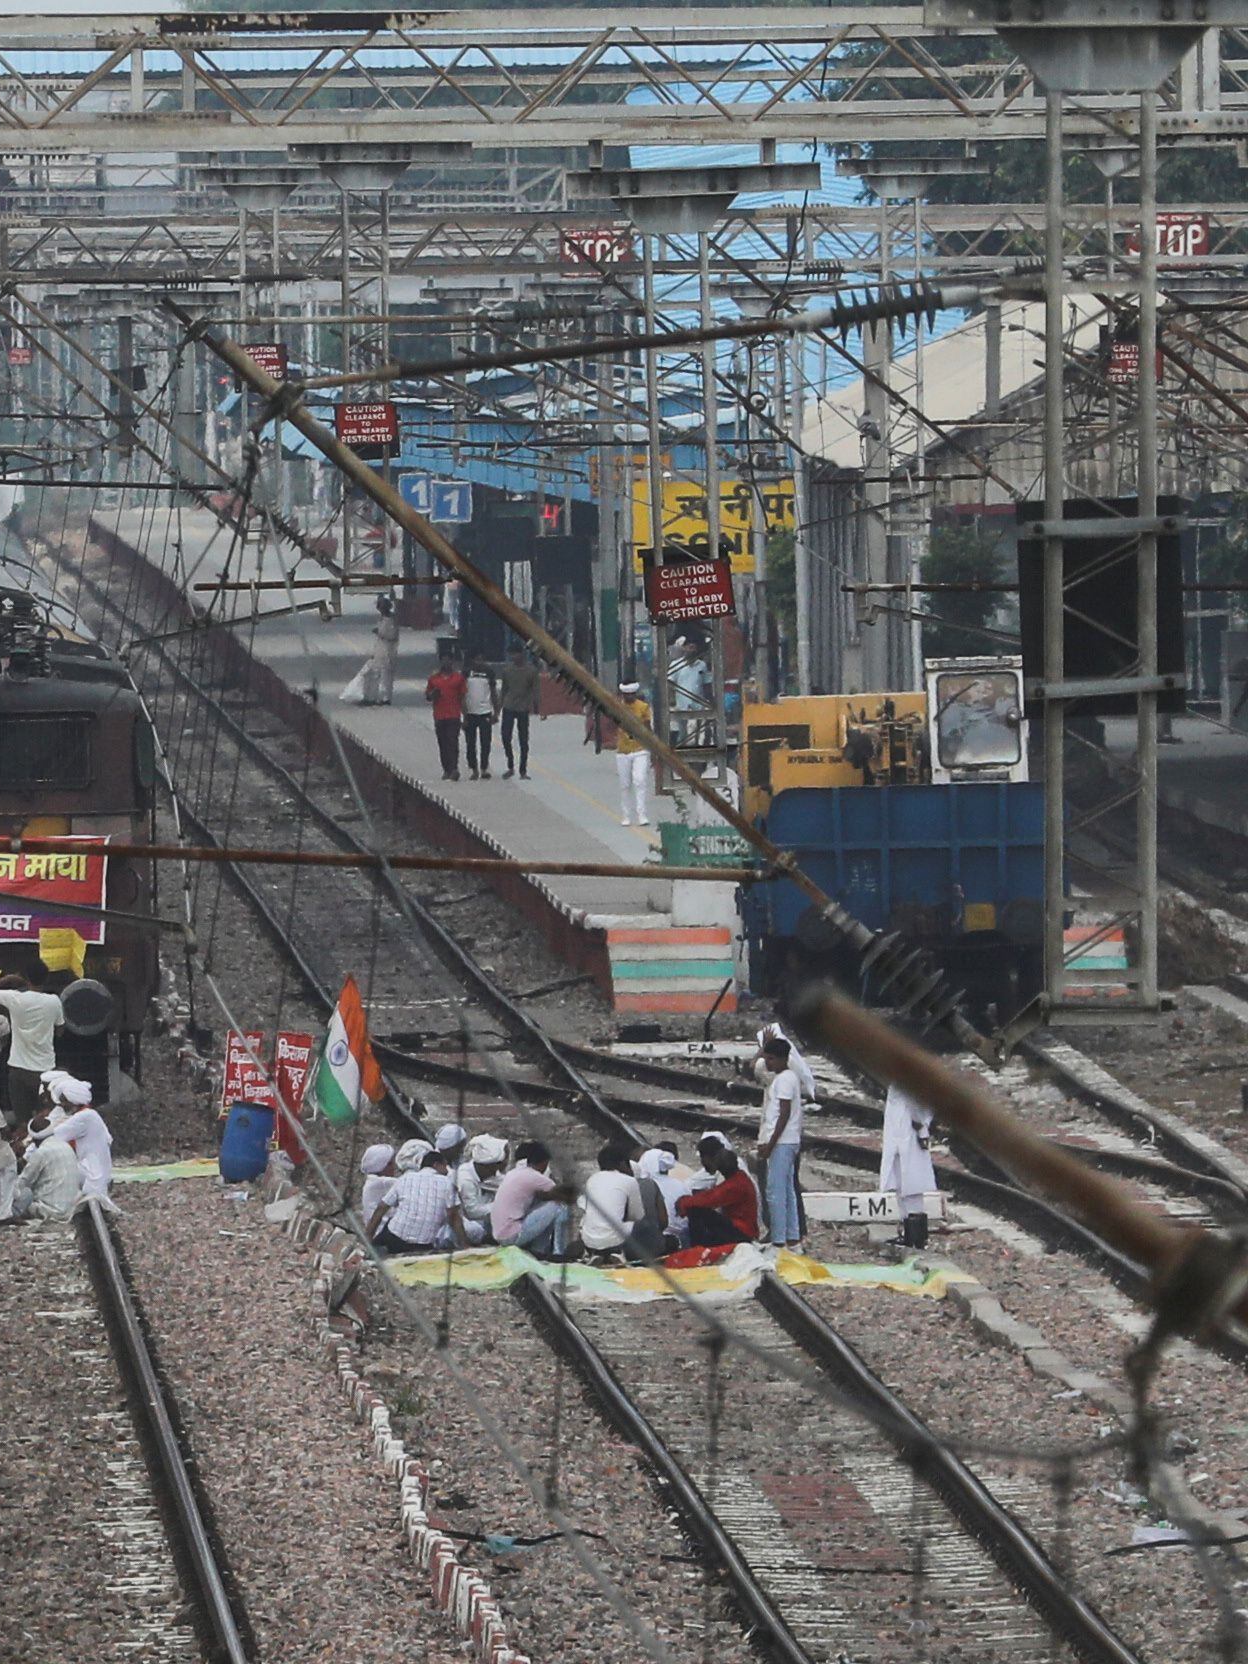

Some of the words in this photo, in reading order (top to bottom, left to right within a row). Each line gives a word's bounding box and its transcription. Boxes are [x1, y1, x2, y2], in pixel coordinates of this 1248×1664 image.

[344, 413, 387, 421] CLEARANCE
[345, 405, 385, 414] CAUTION
[341, 434, 393, 443] RESTRICTED
[411, 479, 429, 507] 1
[443, 489, 460, 516] 1
[661, 562, 715, 579] CAUTION
[660, 574, 719, 589] CLEARANCE
[683, 587, 698, 596] TO
[659, 598, 680, 609] OHE
[685, 593, 724, 606] NEARBY
